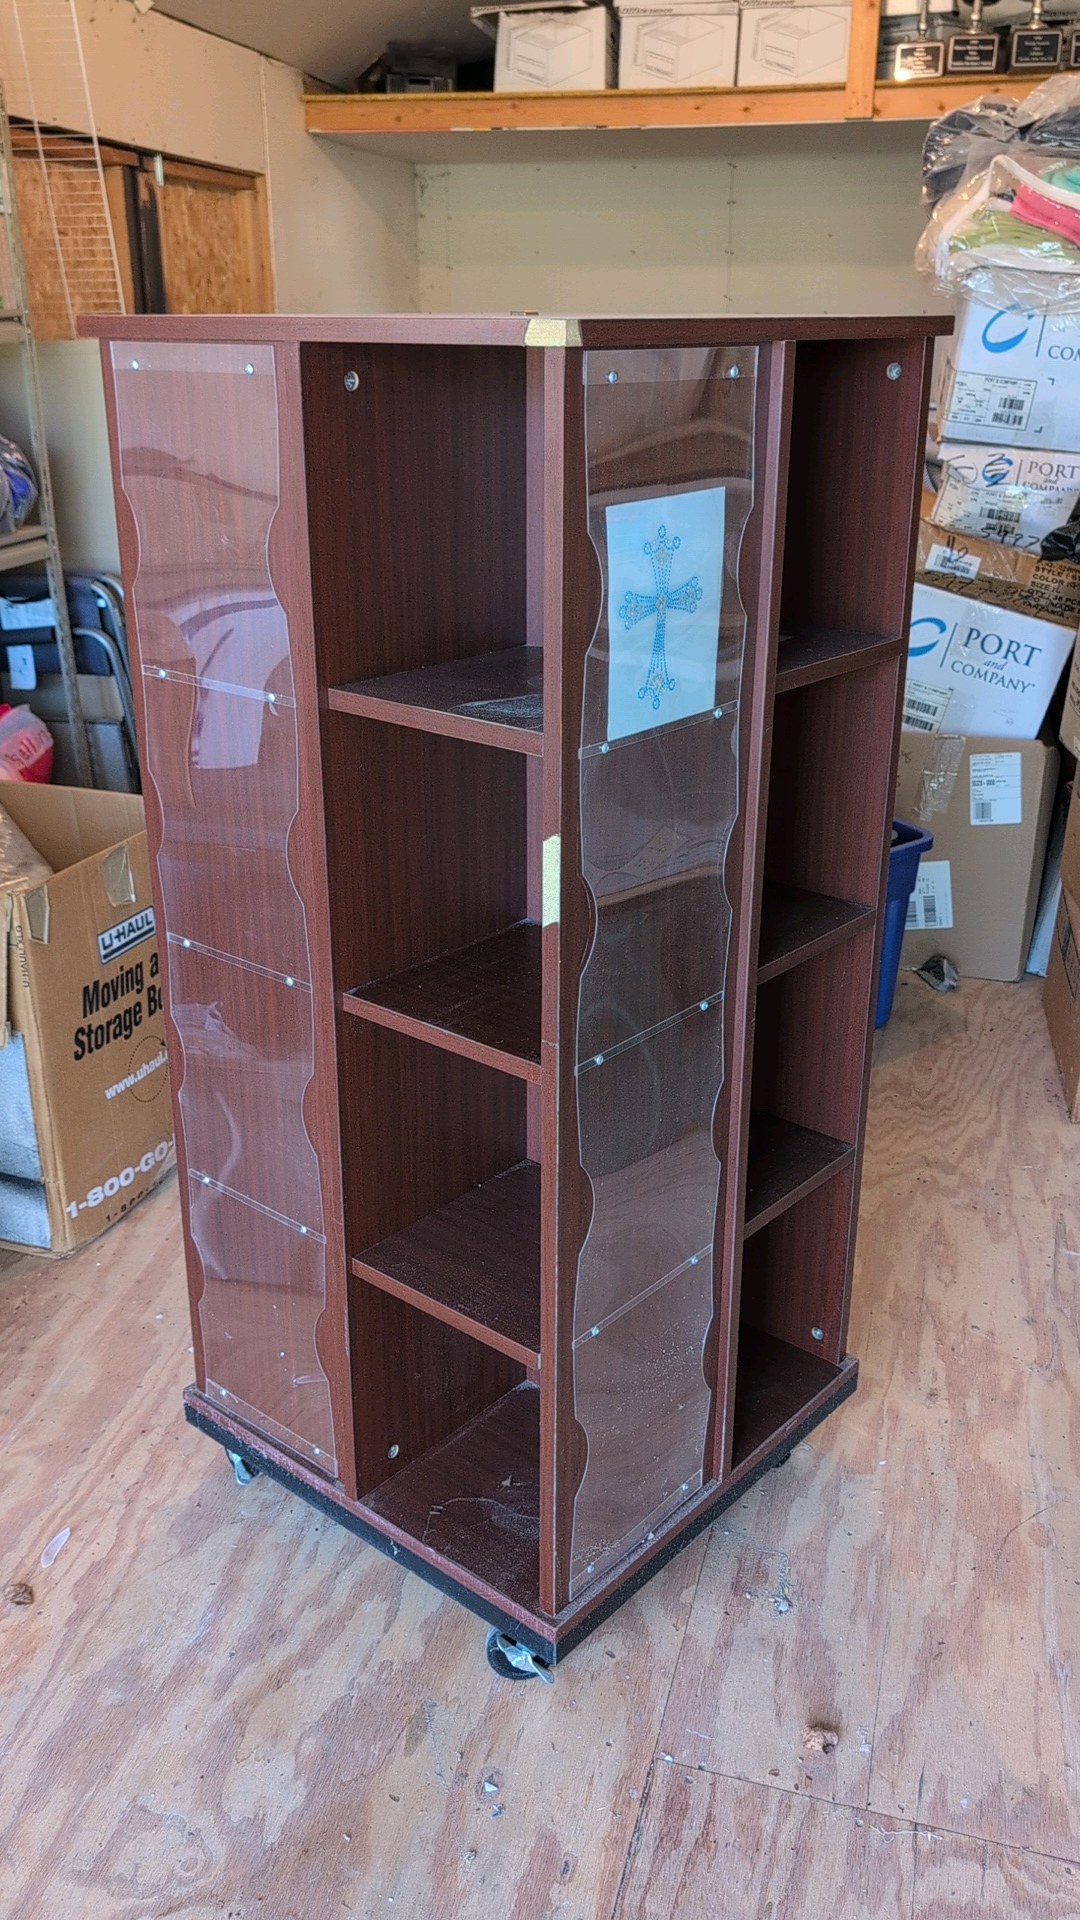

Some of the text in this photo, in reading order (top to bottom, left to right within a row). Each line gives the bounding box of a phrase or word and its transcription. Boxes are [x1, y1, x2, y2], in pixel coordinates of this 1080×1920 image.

[1027, 460, 1080, 479] PORT
[1030, 581, 1050, 591] SIZE
[1032, 573, 1065, 586] COLOR
[963, 627, 1042, 668] PORT
[951, 660, 1031, 694] COMPANY
[984, 659, 1008, 671] and
[101, 912, 153, 950] U-HAUL
[83, 960, 145, 1018] Moving
[73, 1001, 142, 1062] Storage
